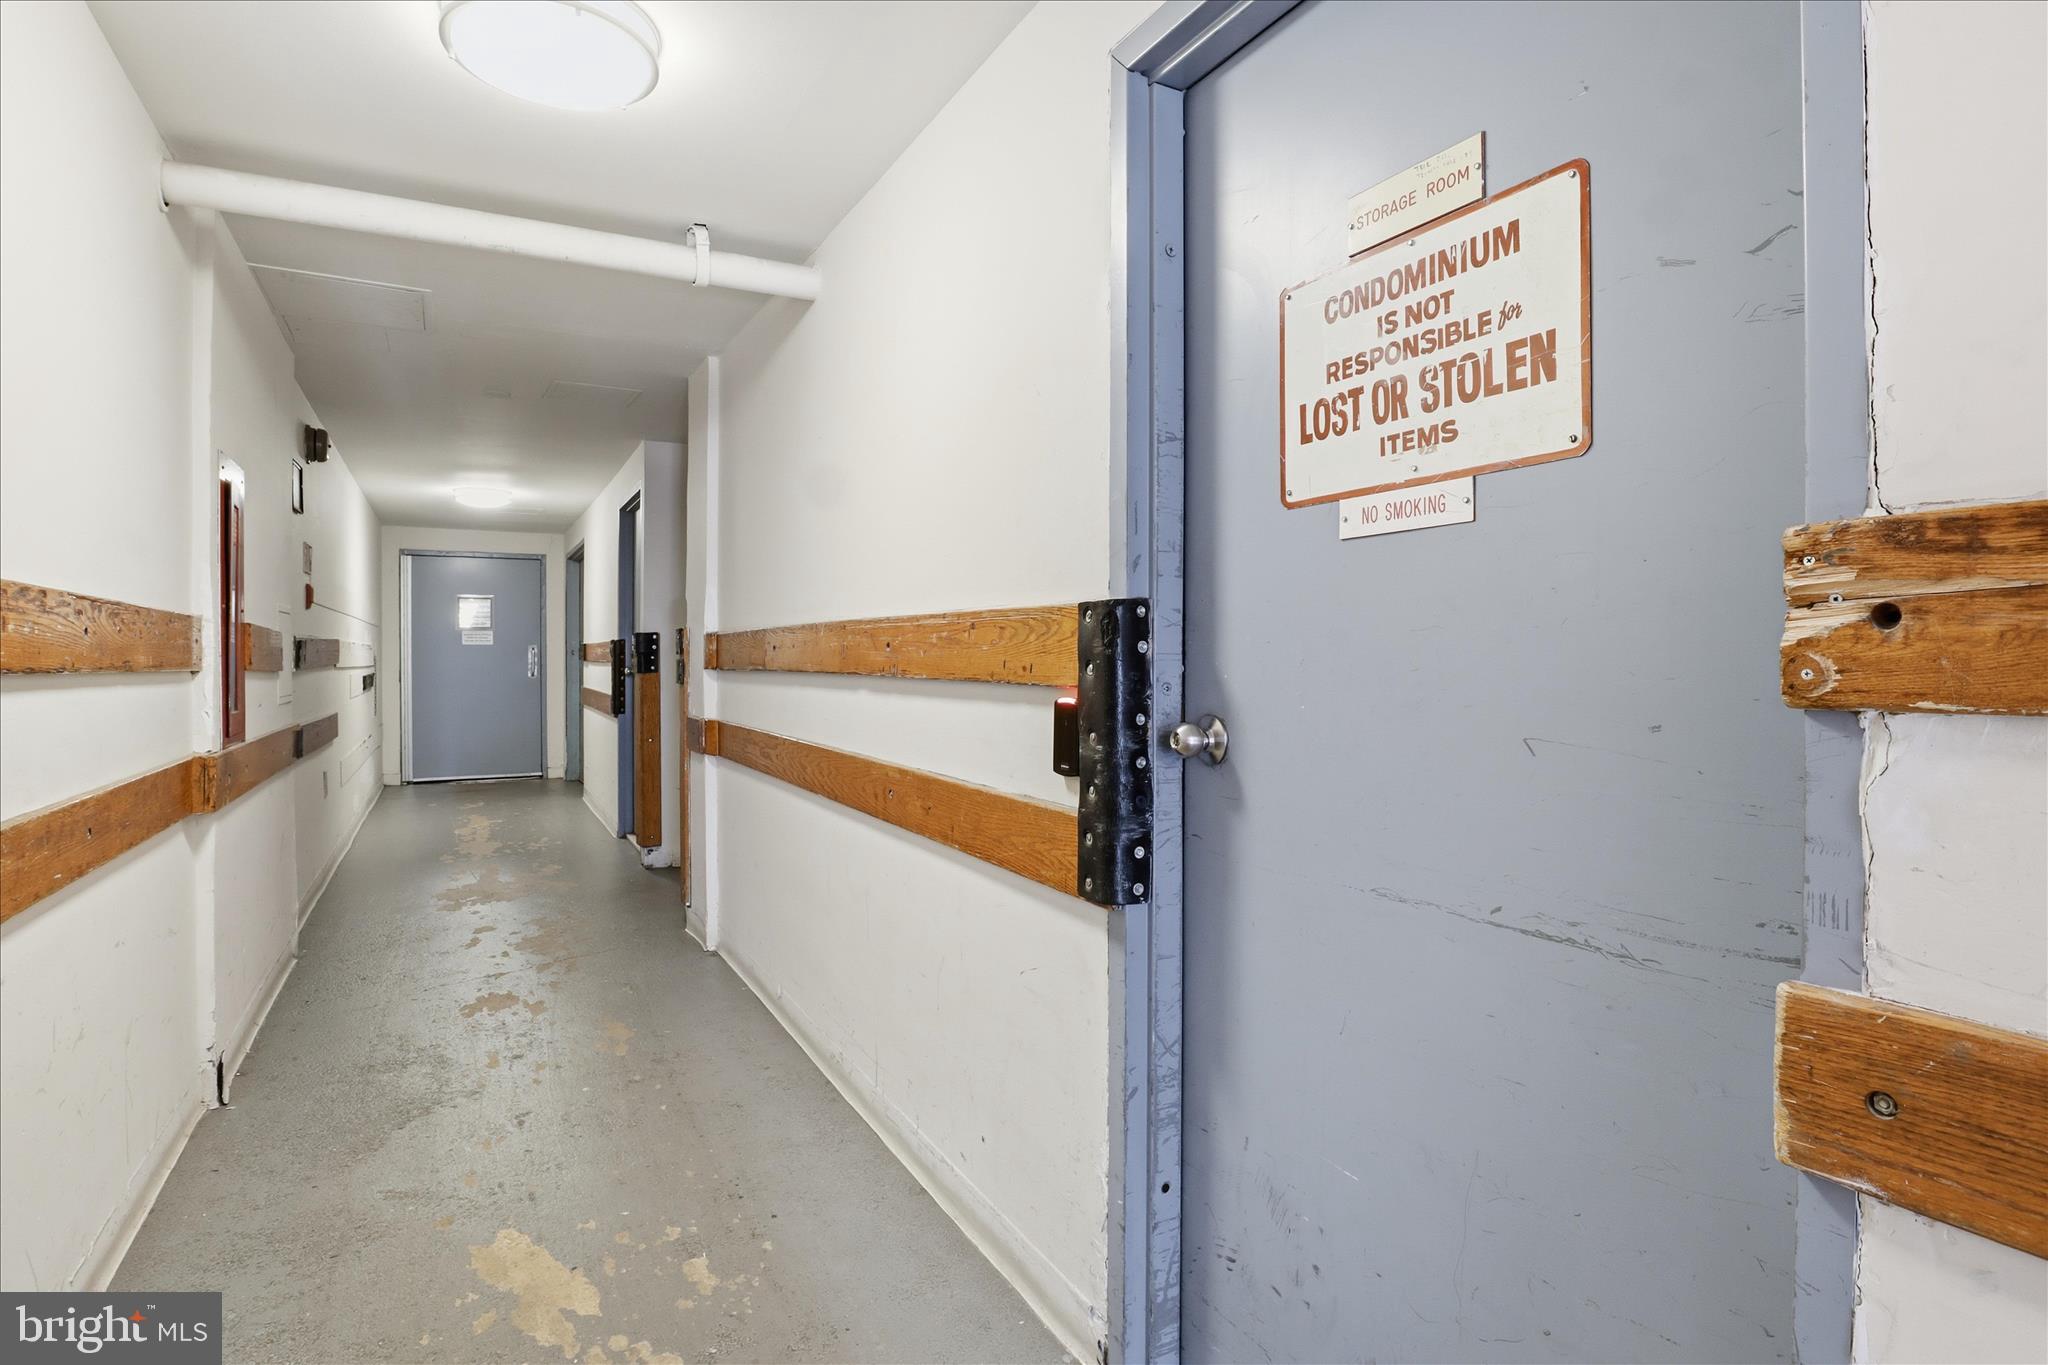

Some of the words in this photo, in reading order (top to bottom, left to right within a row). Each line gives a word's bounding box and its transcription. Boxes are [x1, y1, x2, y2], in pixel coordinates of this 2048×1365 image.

[1356, 189, 1417, 230] STORAGE
[1426, 165, 1470, 198] ROOM
[1324, 218, 1520, 325] CONDOMINIUM
[1326, 310, 1492, 385] RESPONSIBLE
[1497, 300, 1523, 331] for
[1377, 309, 1399, 337] IS
[1405, 289, 1455, 328] NOT
[1299, 386, 1365, 446] LOST
[1371, 373, 1409, 426] OR
[1419, 328, 1557, 414] STOLEN
[1380, 419, 1459, 457] ITEMS
[1361, 501, 1379, 525] NO
[1385, 494, 1447, 521] SMOKING
